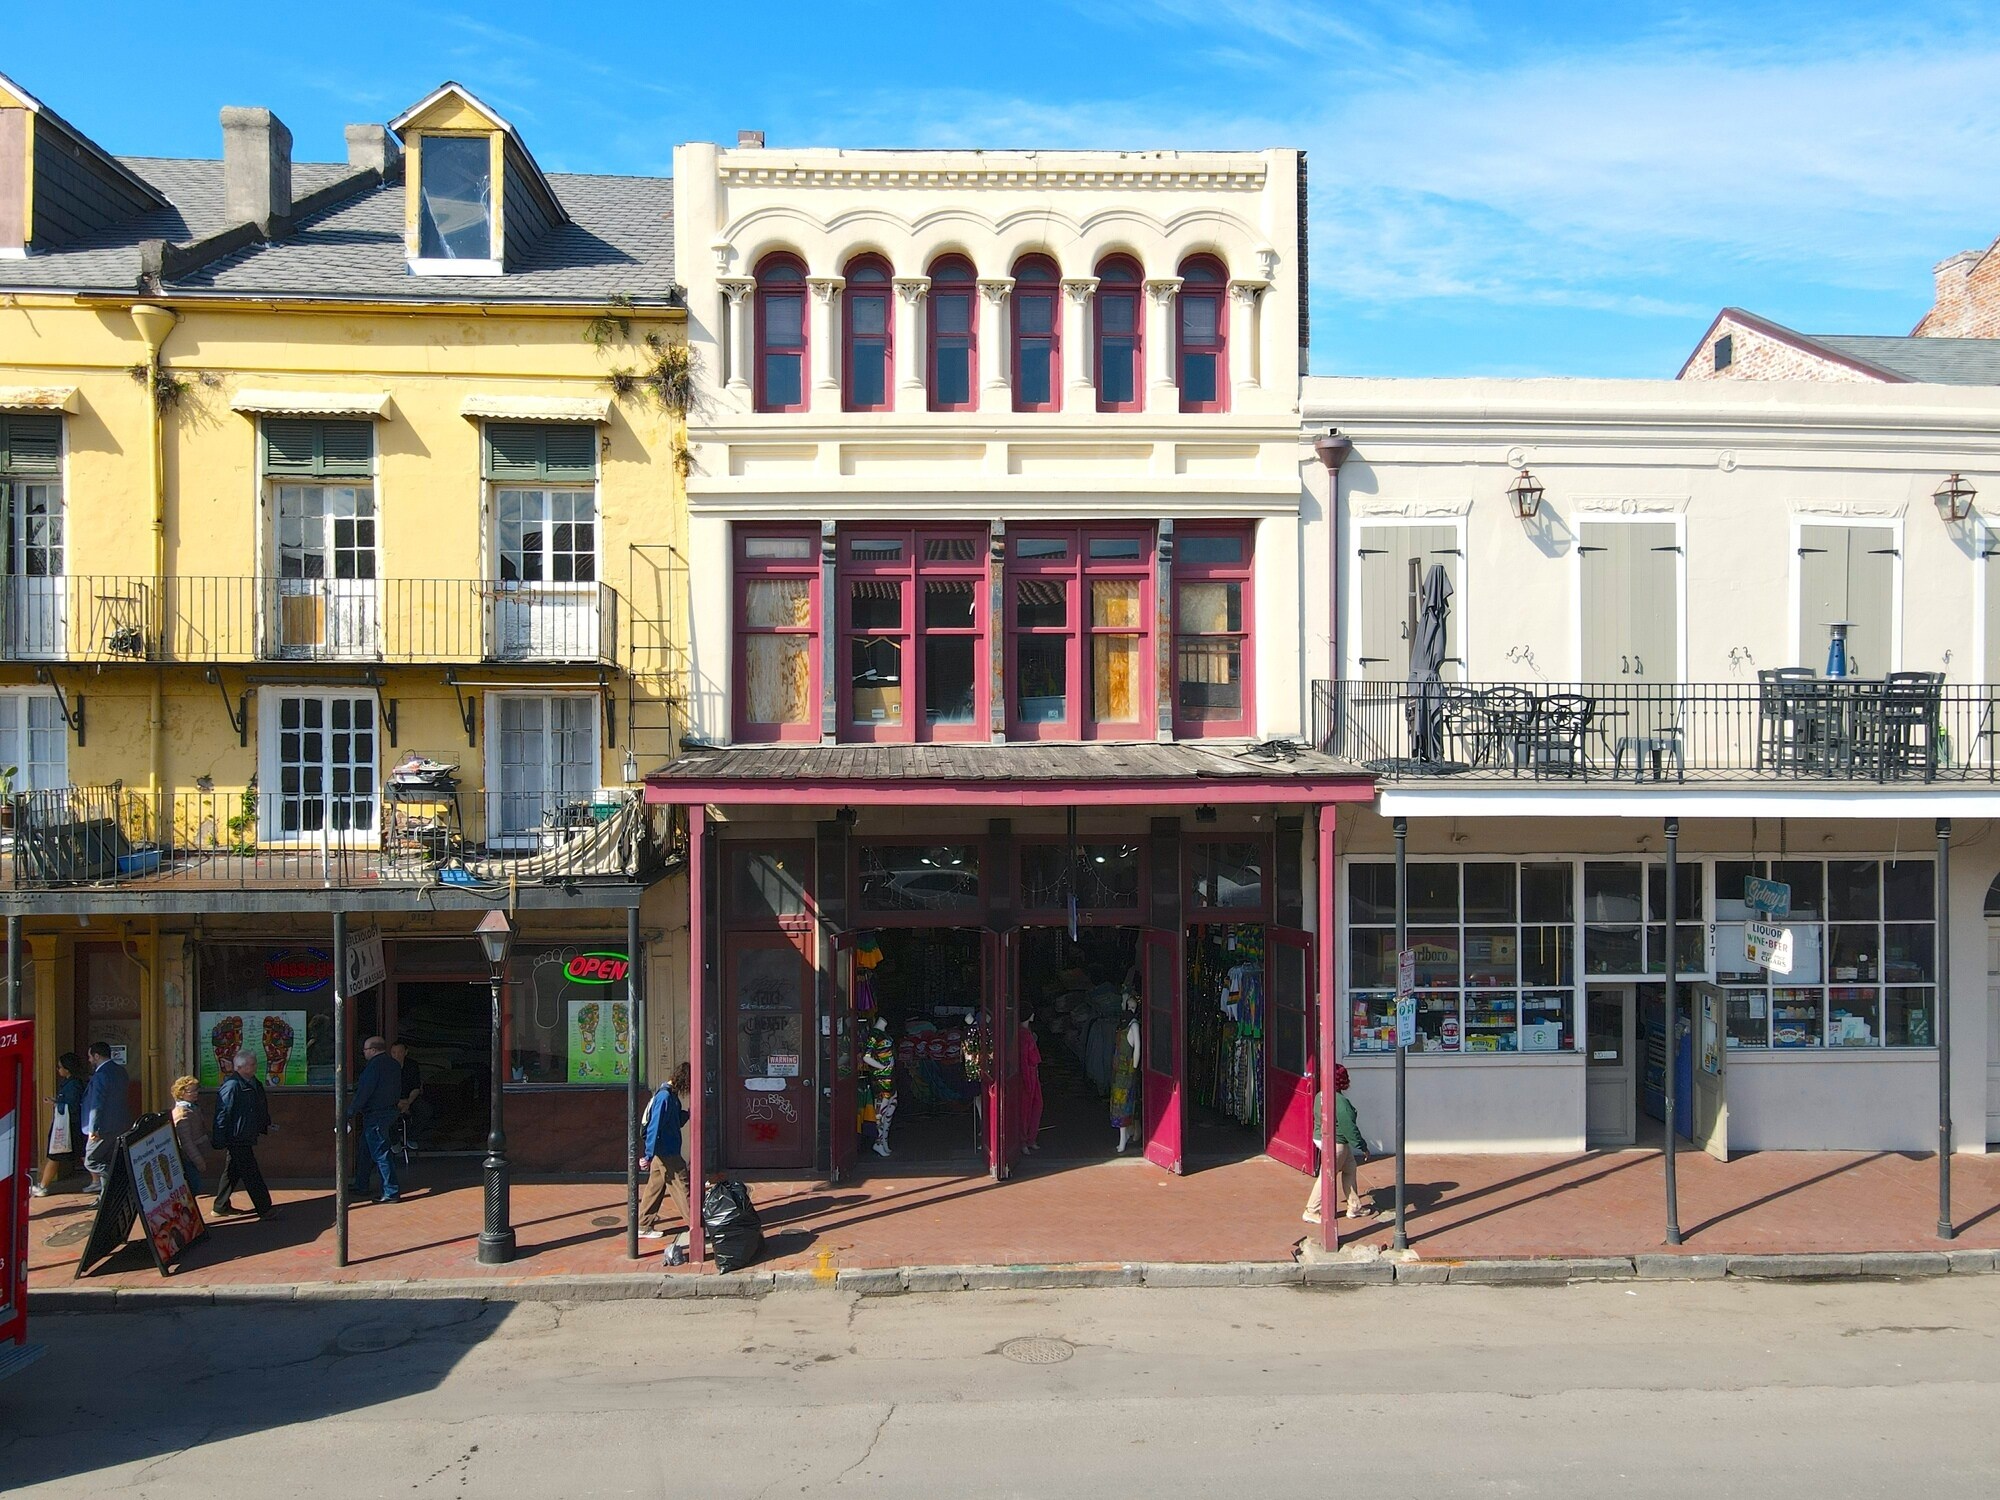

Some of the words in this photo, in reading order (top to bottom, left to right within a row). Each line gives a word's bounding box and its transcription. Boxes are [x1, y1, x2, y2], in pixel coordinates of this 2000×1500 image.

[1745, 880, 1787, 910] Sidney's
[1752, 924, 1783, 938] LIQUOR
[1414, 946, 1449, 962] rlboro
[1761, 955, 1787, 967] CIGARS
[568, 957, 629, 980] OPEN
[349, 979, 364, 993] FOOT
[770, 1056, 797, 1064] WARNING
